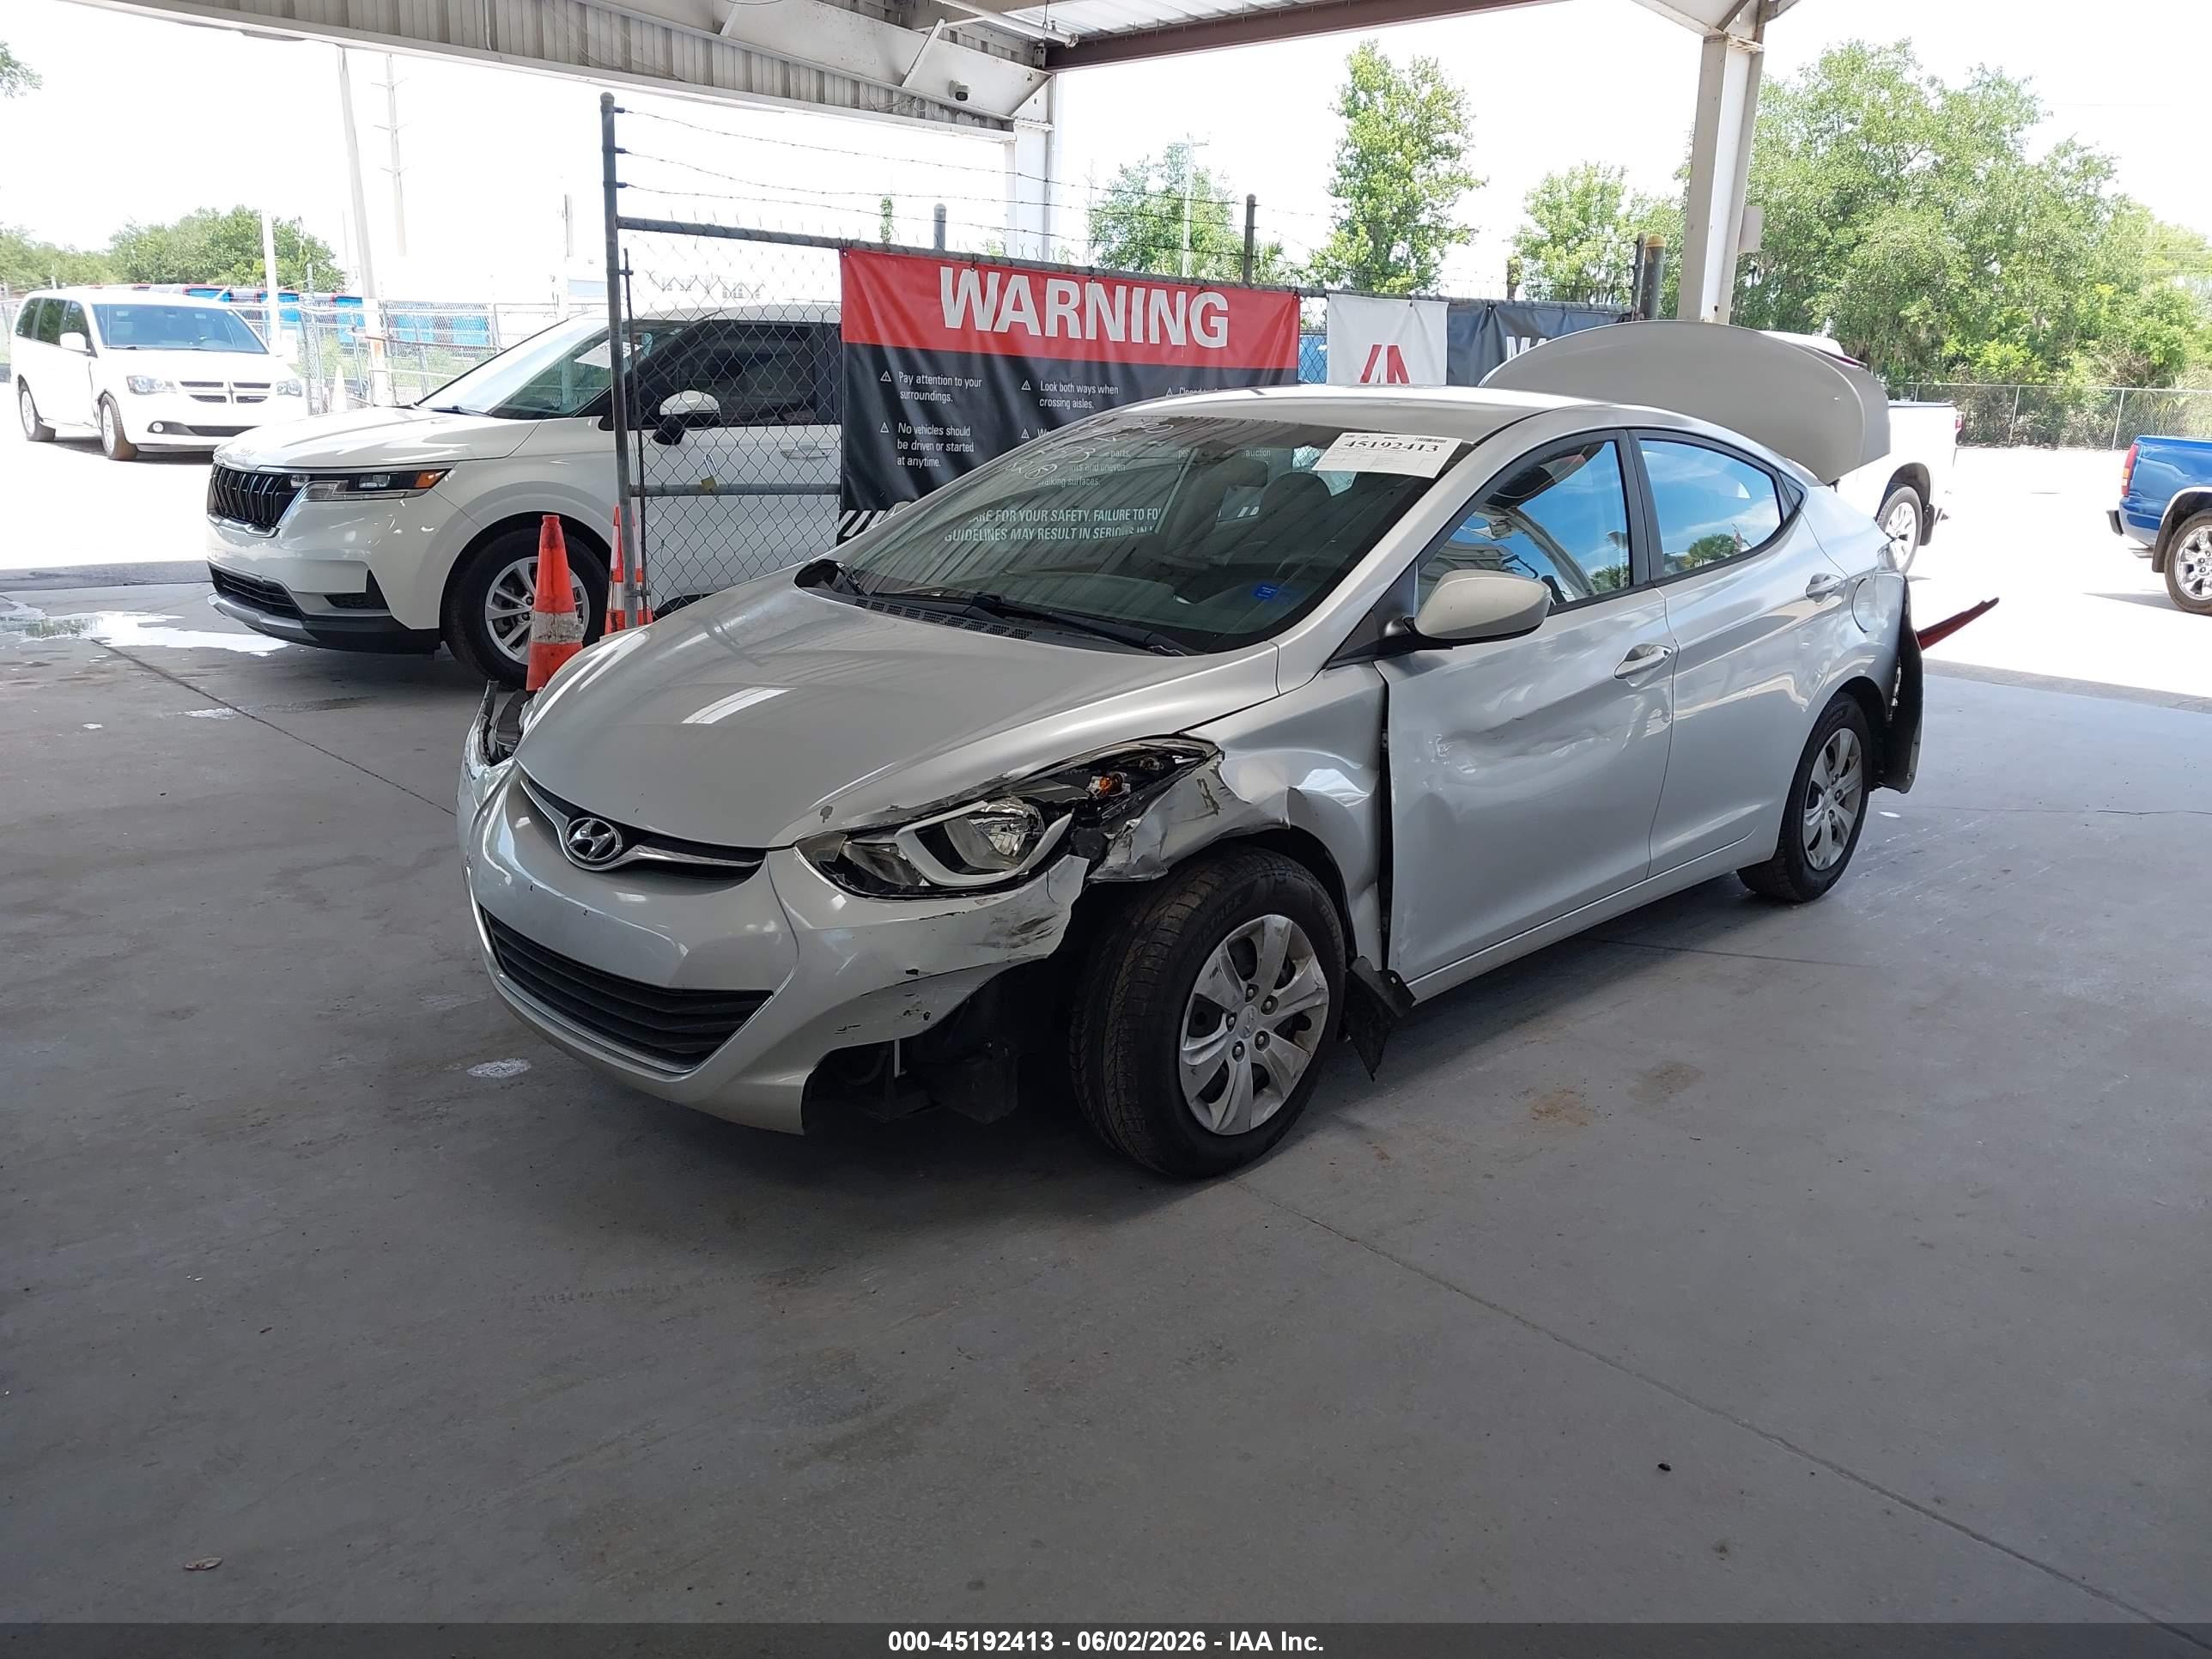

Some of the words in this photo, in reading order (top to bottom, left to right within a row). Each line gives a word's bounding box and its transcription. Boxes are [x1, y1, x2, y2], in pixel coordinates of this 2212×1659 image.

[940, 266, 1229, 348] WARNING
[898, 371, 914, 386] Pay
[916, 374, 953, 386] attention
[954, 377, 963, 386] to
[964, 379, 982, 390] your
[1040, 380, 1058, 392] Look
[1059, 381, 1075, 392] both
[1077, 385, 1097, 396] ways
[1097, 384, 1119, 395] when
[900, 390, 953, 404] surroundings.
[1039, 397, 1071, 410] crossing
[1073, 398, 1095, 409] aisles.
[898, 422, 912, 434] No
[914, 423, 944, 435] vehicles
[945, 426, 971, 436] should
[896, 438, 908, 450] be
[911, 440, 934, 452] driven
[936, 443, 945, 452] or
[945, 441, 975, 453] started
[1344, 441, 1439, 453] 45192413
[896, 456, 905, 465] at
[907, 456, 941, 469] anytime.
[969, 509, 994, 522] ARE
[995, 509, 1017, 522] FOR
[1019, 509, 1048, 522] YOUR
[1093, 508, 1131, 521] FAILURE
[1133, 508, 1145, 521] TO
[945, 528, 1008, 542] GUIDELINES
[1010, 528, 1035, 540] MAY
[1037, 527, 1079, 540] RESULT
[1079, 527, 1091, 539] IN
